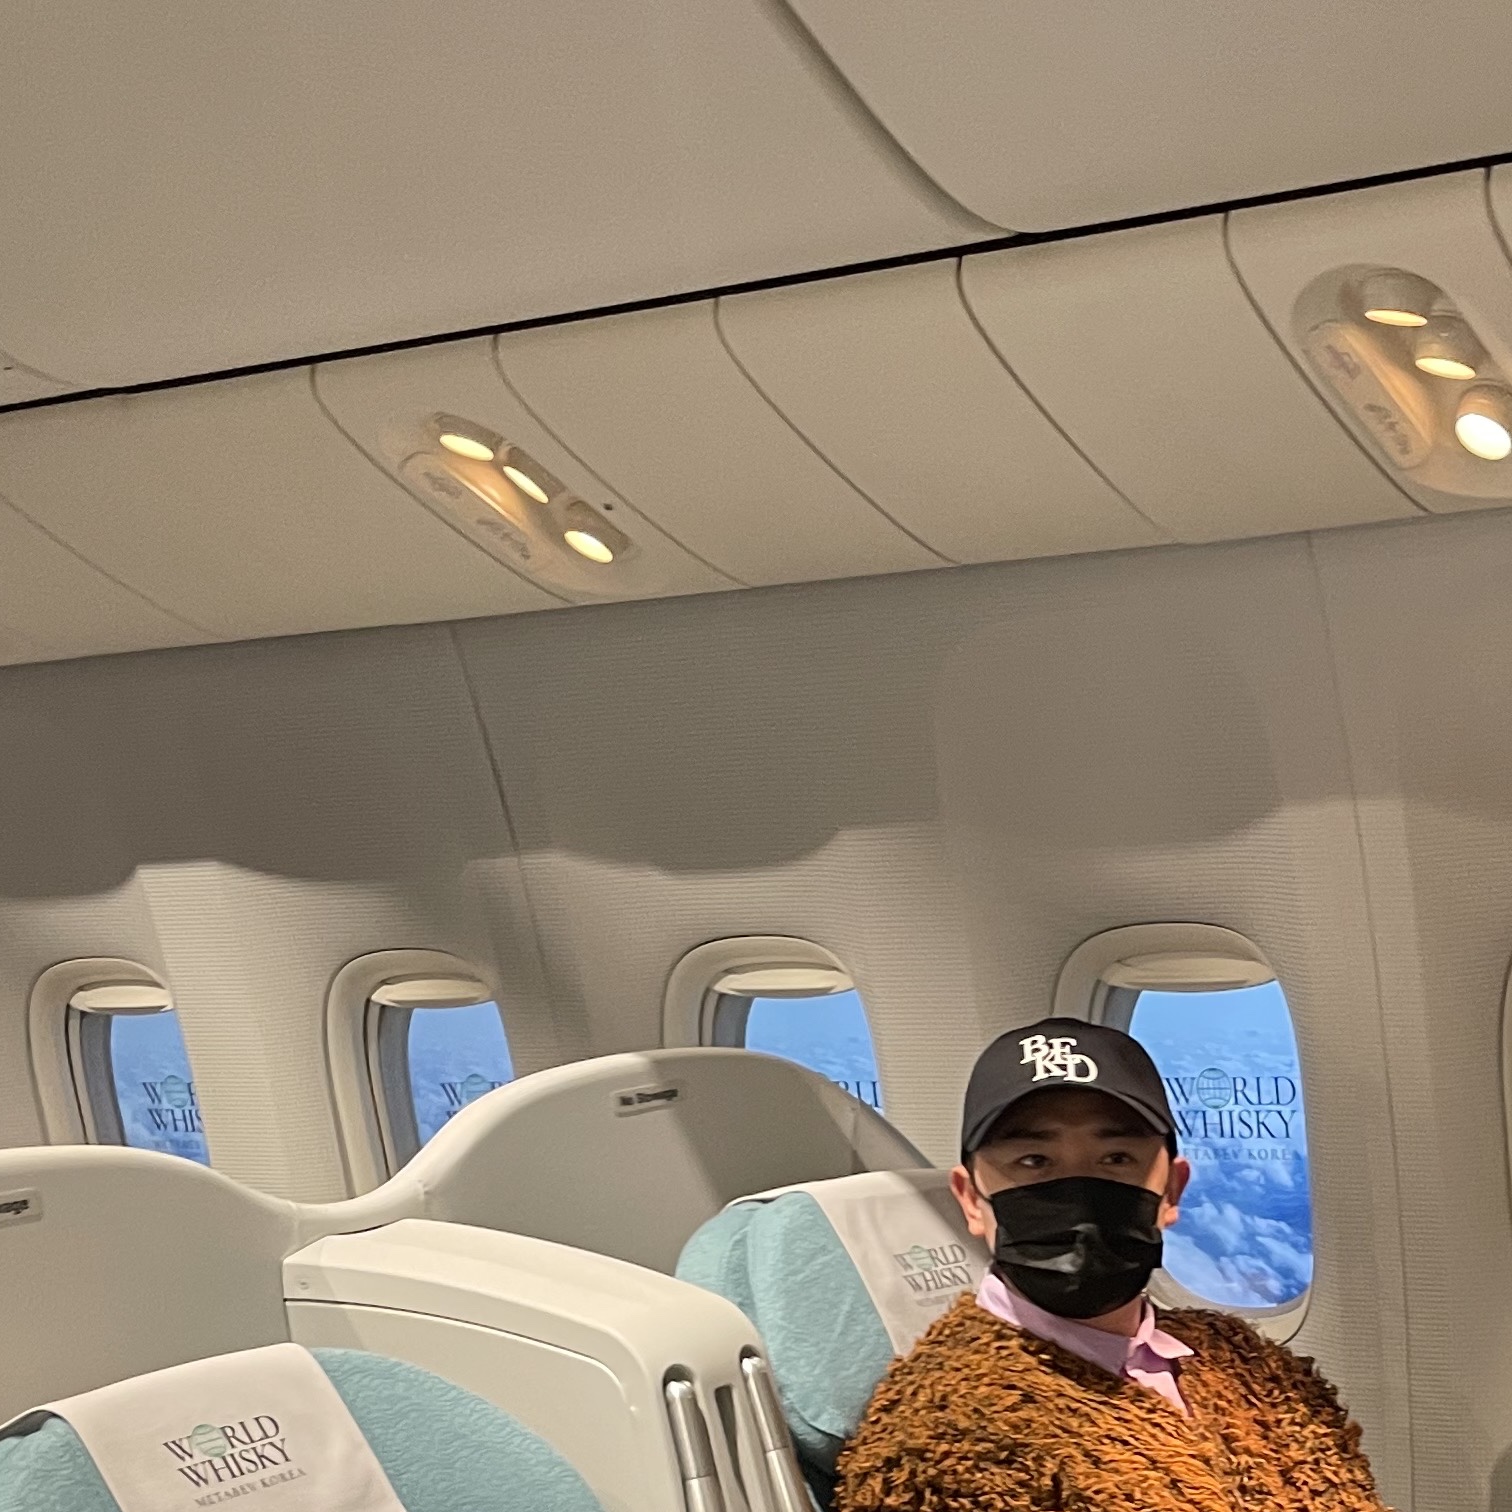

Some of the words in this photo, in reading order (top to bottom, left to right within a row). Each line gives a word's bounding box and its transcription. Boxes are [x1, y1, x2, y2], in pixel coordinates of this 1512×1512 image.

[1164, 1067, 1297, 1109] WORLD
[1174, 1109, 1297, 1139] WHISKY
[893, 1244, 967, 1272] WORLD
[902, 1263, 974, 1293] WHISKY
[162, 1415, 280, 1462] WORLD
[177, 1438, 291, 1488] WHISKY
[260, 1467, 307, 1488] KOREA
